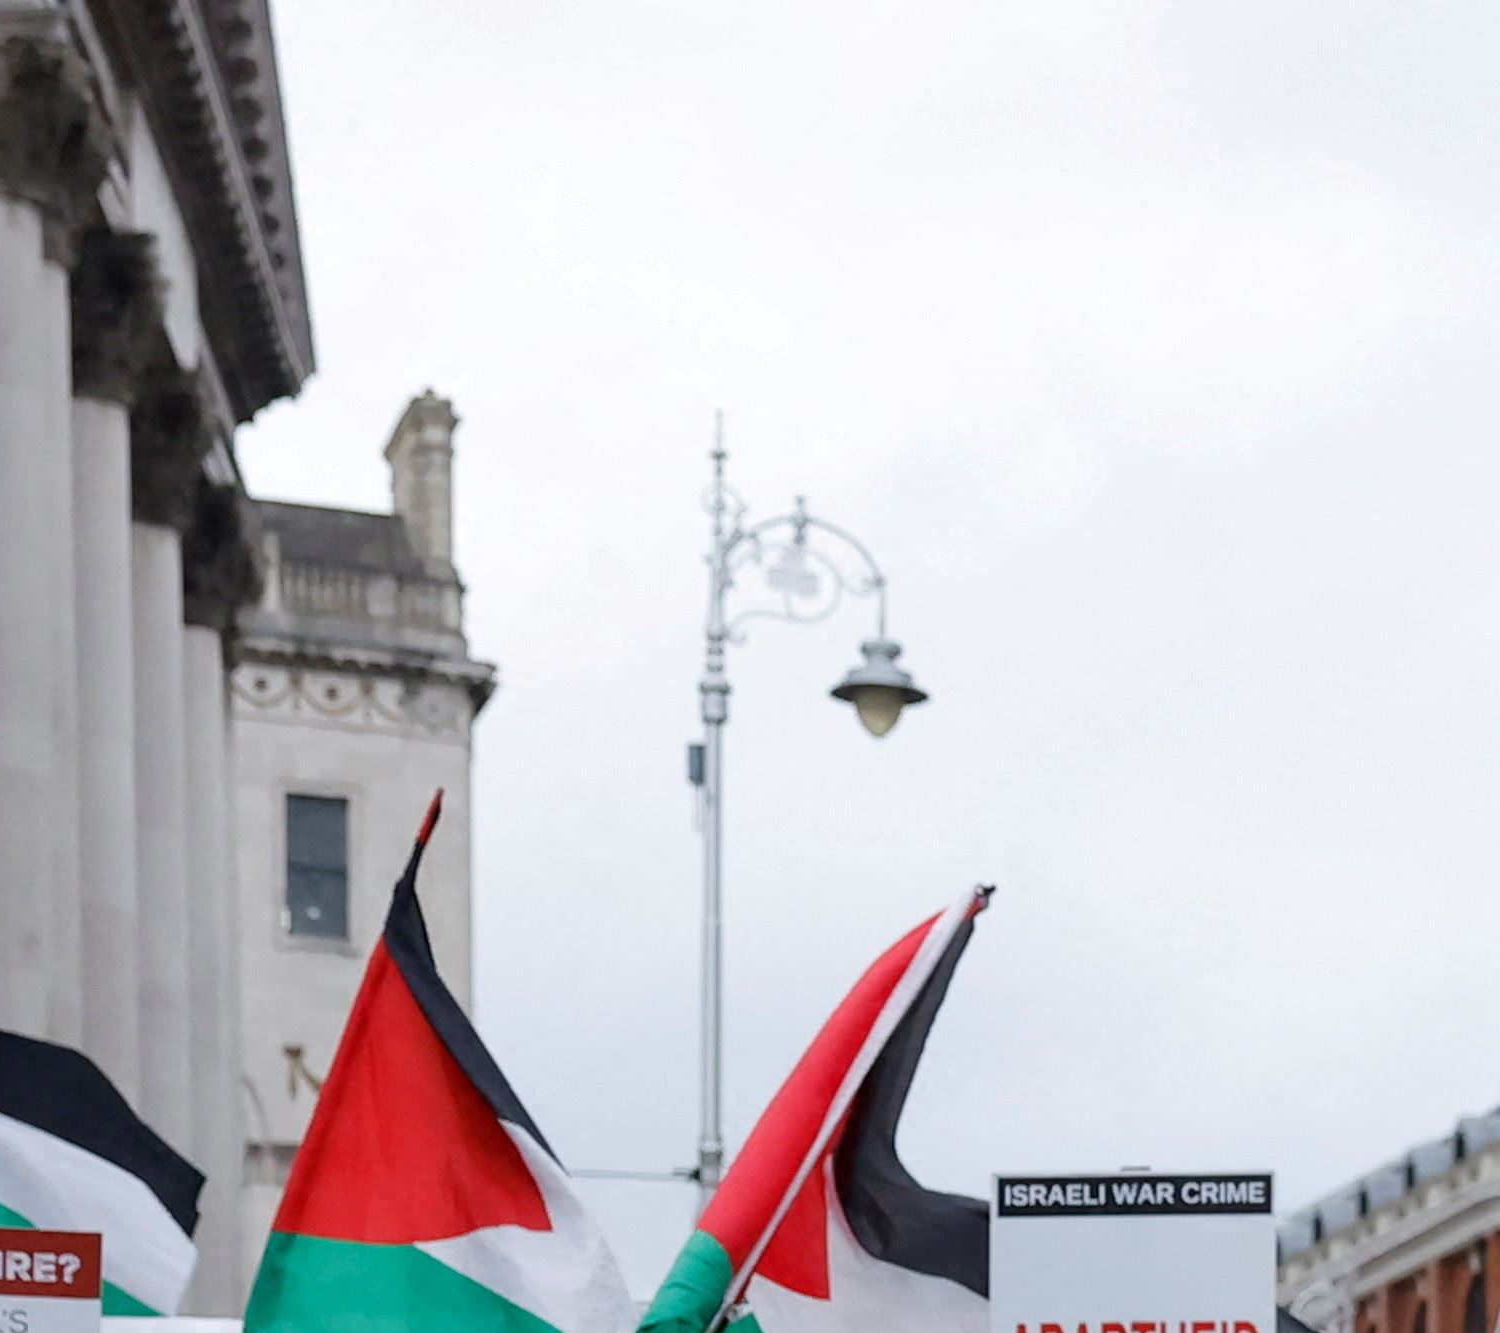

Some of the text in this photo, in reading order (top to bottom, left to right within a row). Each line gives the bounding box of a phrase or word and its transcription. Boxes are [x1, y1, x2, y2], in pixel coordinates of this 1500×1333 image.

[1004, 1180, 1266, 1207] ISRAELI WAR CRIME
